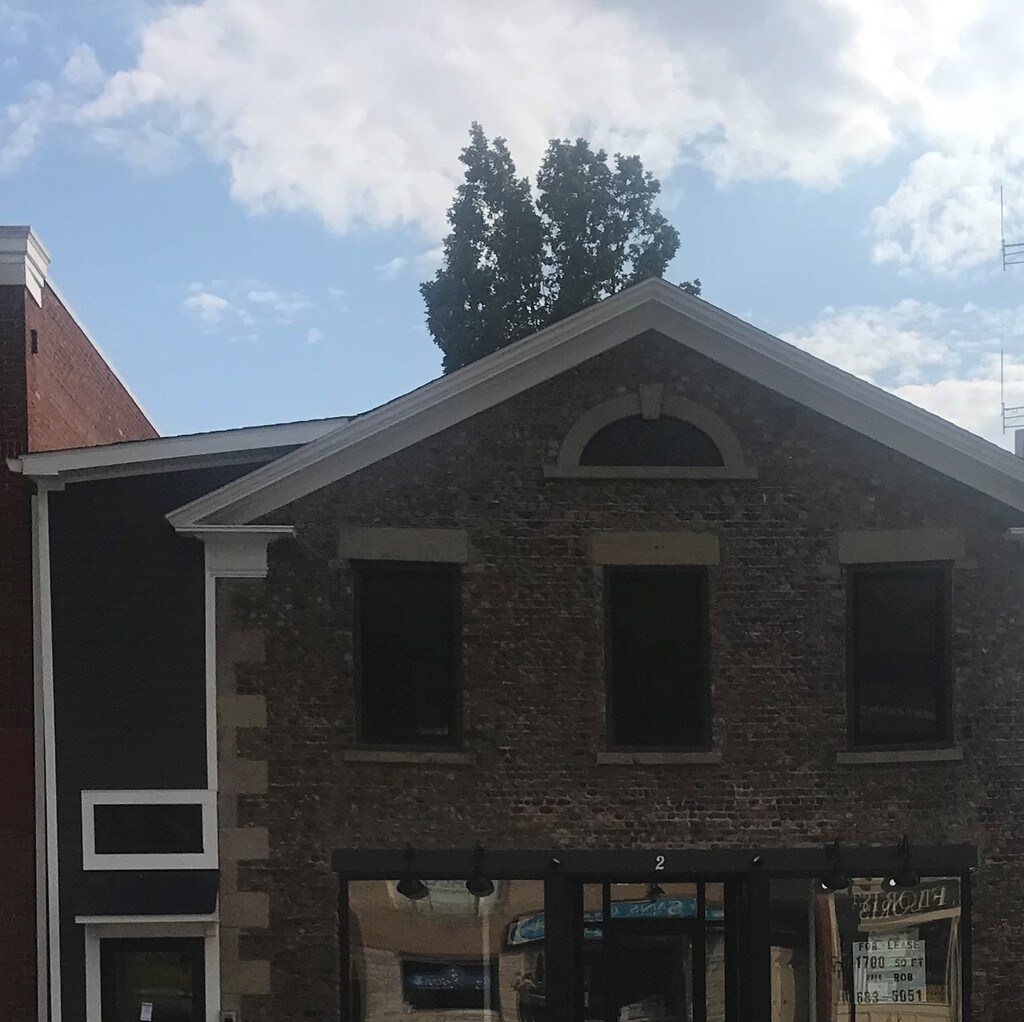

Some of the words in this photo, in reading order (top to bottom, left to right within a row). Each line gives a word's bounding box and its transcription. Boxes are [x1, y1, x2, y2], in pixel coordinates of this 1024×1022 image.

[655, 855, 665, 870] 2
[858, 942, 878, 951] FOR
[887, 940, 920, 950] LEASE
[856, 956, 886, 969] 1700
[911, 958, 924, 967] FT
[894, 973, 914, 982] ROB
